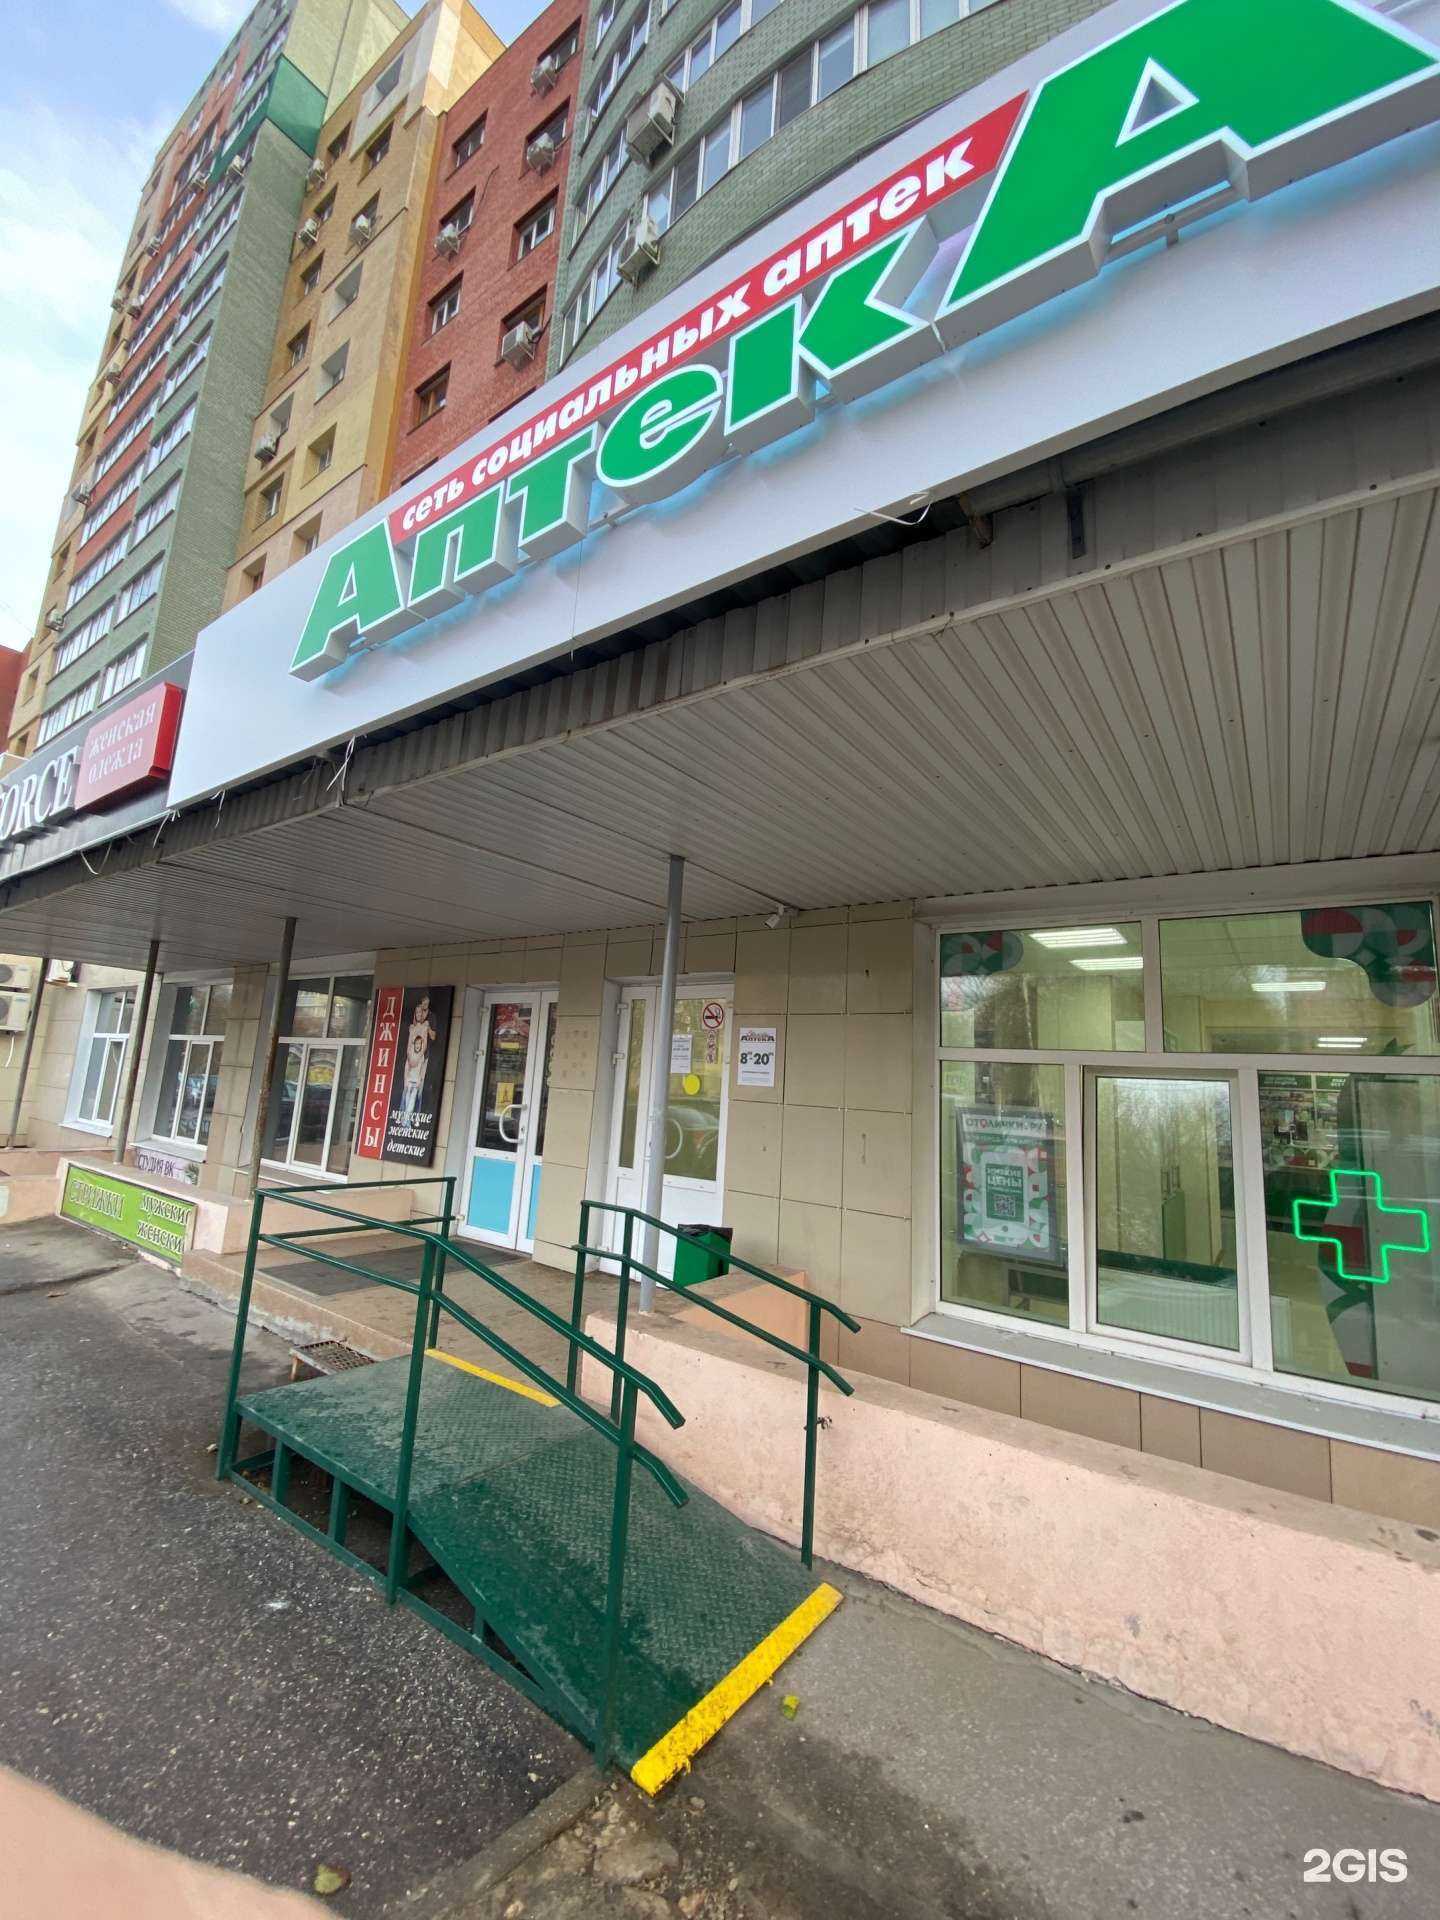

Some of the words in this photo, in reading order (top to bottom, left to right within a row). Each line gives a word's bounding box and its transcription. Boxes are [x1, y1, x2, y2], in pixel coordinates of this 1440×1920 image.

[401, 476, 466, 532] сеть
[471, 280, 752, 487] социальных
[761, 136, 977, 298] аптек
[363, 996, 396, 1149] ДЖИНСЫ
[389, 1110, 433, 1124] мужские
[388, 1126, 430, 1140] женские
[386, 1138, 426, 1157] детские
